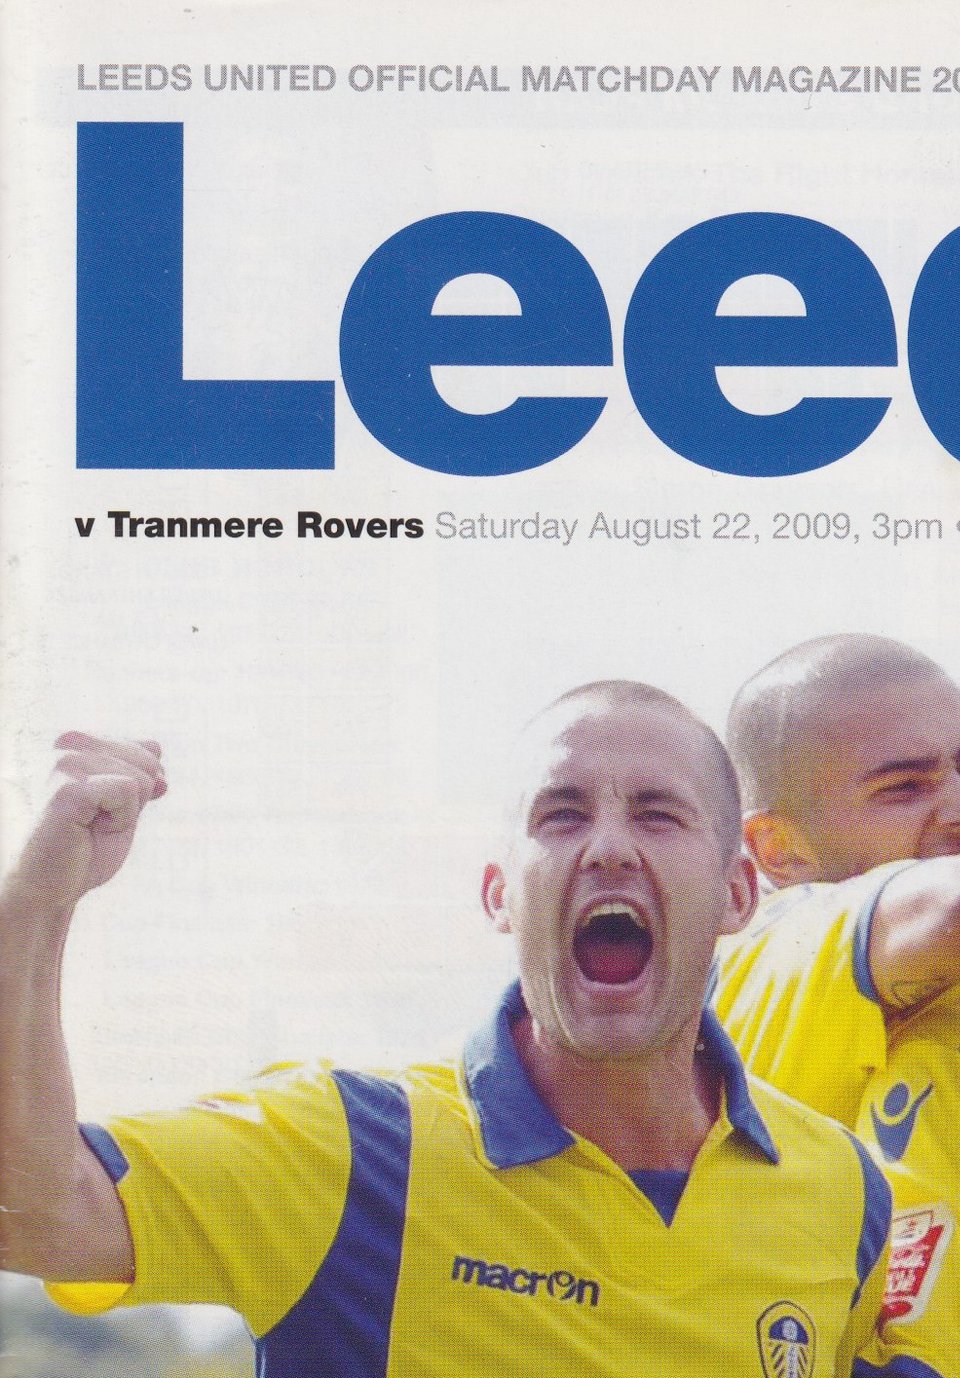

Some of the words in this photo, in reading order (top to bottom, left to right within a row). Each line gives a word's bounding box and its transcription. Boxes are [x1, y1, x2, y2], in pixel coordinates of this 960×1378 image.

[77, 64, 192, 93] LEEDS
[205, 64, 336, 93] UNITED
[349, 65, 510, 94] OFFICIAL
[522, 65, 720, 94] MATCHDAY
[733, 66, 921, 94] MAGAZINE
[75, 518, 96, 539] v
[107, 511, 284, 540] Tranmere
[298, 511, 425, 540] Rovers
[435, 511, 579, 548] Saturday
[588, 512, 703, 548] August
[712, 513, 760, 545] 22,
[773, 513, 860, 545] 2009,
[872, 513, 944, 548] 3pm
